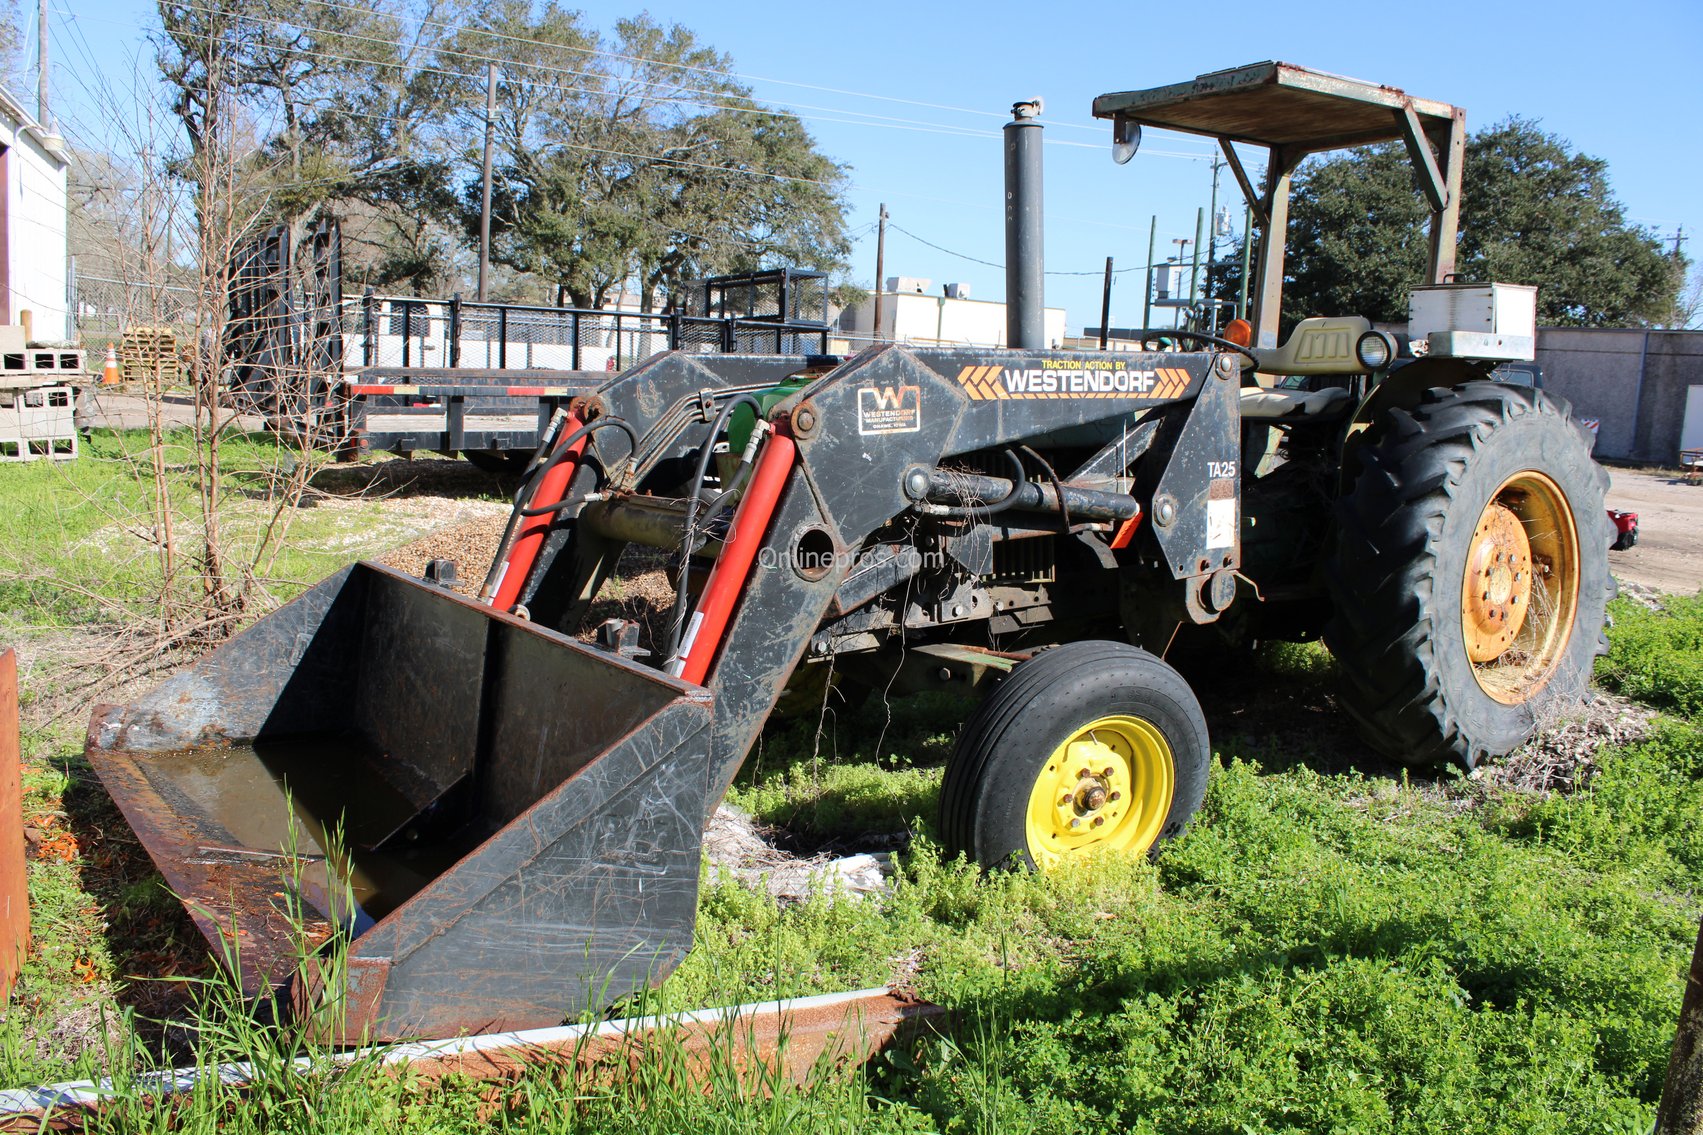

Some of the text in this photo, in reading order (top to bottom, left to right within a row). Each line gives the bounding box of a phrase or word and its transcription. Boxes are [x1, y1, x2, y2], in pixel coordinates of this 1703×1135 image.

[1042, 360, 1126, 370] TRACTION ACTION BY
[1004, 369, 1155, 392] WESTENDORF
[862, 408, 916, 418] WESTENDORF
[1207, 461, 1236, 478] TA25
